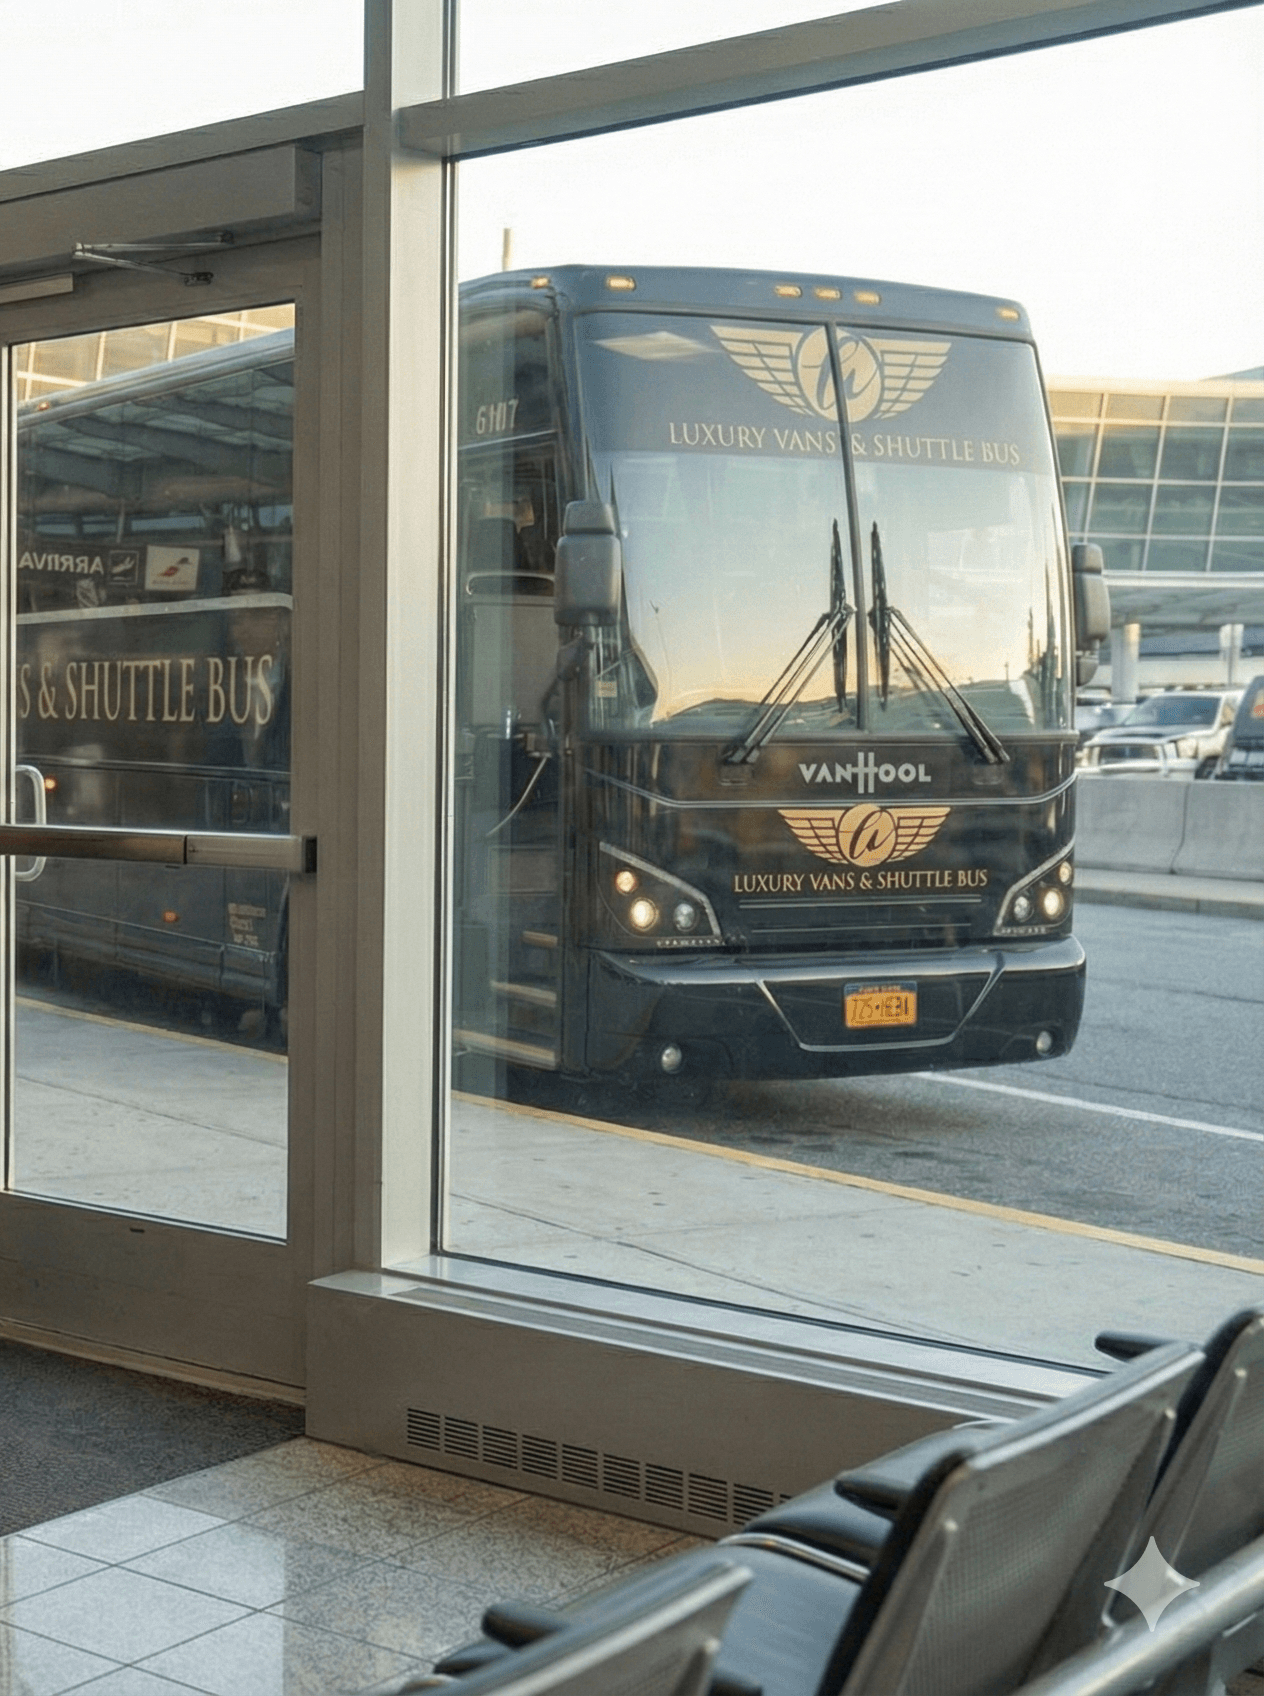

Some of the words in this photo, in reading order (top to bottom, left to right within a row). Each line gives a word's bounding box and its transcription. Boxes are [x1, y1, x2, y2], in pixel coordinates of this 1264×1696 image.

[669, 422, 767, 449] LUXURY
[774, 428, 836, 452] VANS
[851, 433, 868, 454] &
[874, 434, 975, 462] SHUTTLE
[982, 442, 1021, 465] BUS
[38, 661, 58, 719] &
[65, 657, 196, 721] SHUTTLE
[207, 655, 274, 724] BUS
[734, 873, 804, 893] LUXURY
[810, 872, 855, 891] VANS
[859, 872, 873, 890] &
[877, 870, 953, 889] SHUTTLE
[957, 869, 988, 887] BUS
